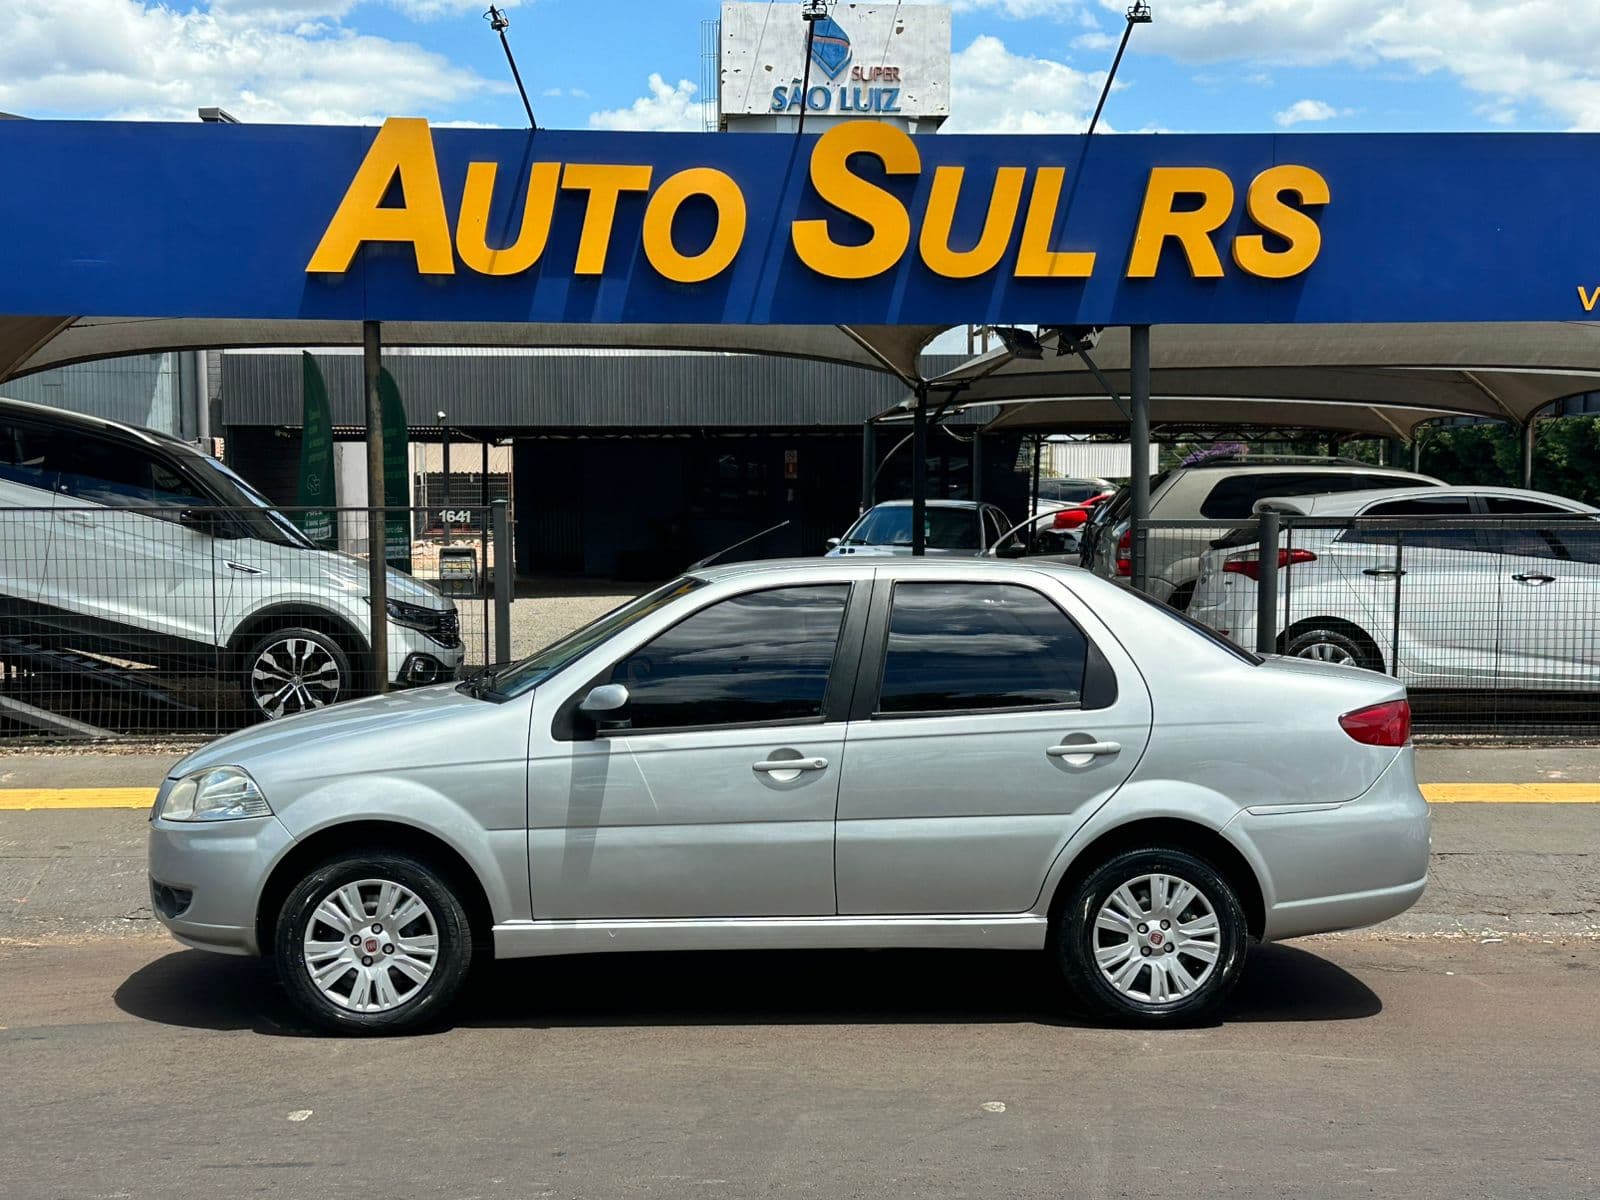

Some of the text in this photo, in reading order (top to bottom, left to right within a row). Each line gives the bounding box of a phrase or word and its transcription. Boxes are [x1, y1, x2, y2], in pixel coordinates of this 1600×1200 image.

[851, 65, 901, 82] SUPER
[771, 78, 900, 112] SÃO LUIZ
[305, 117, 1331, 283] AUTO SUL RS
[439, 510, 470, 522] 1641
